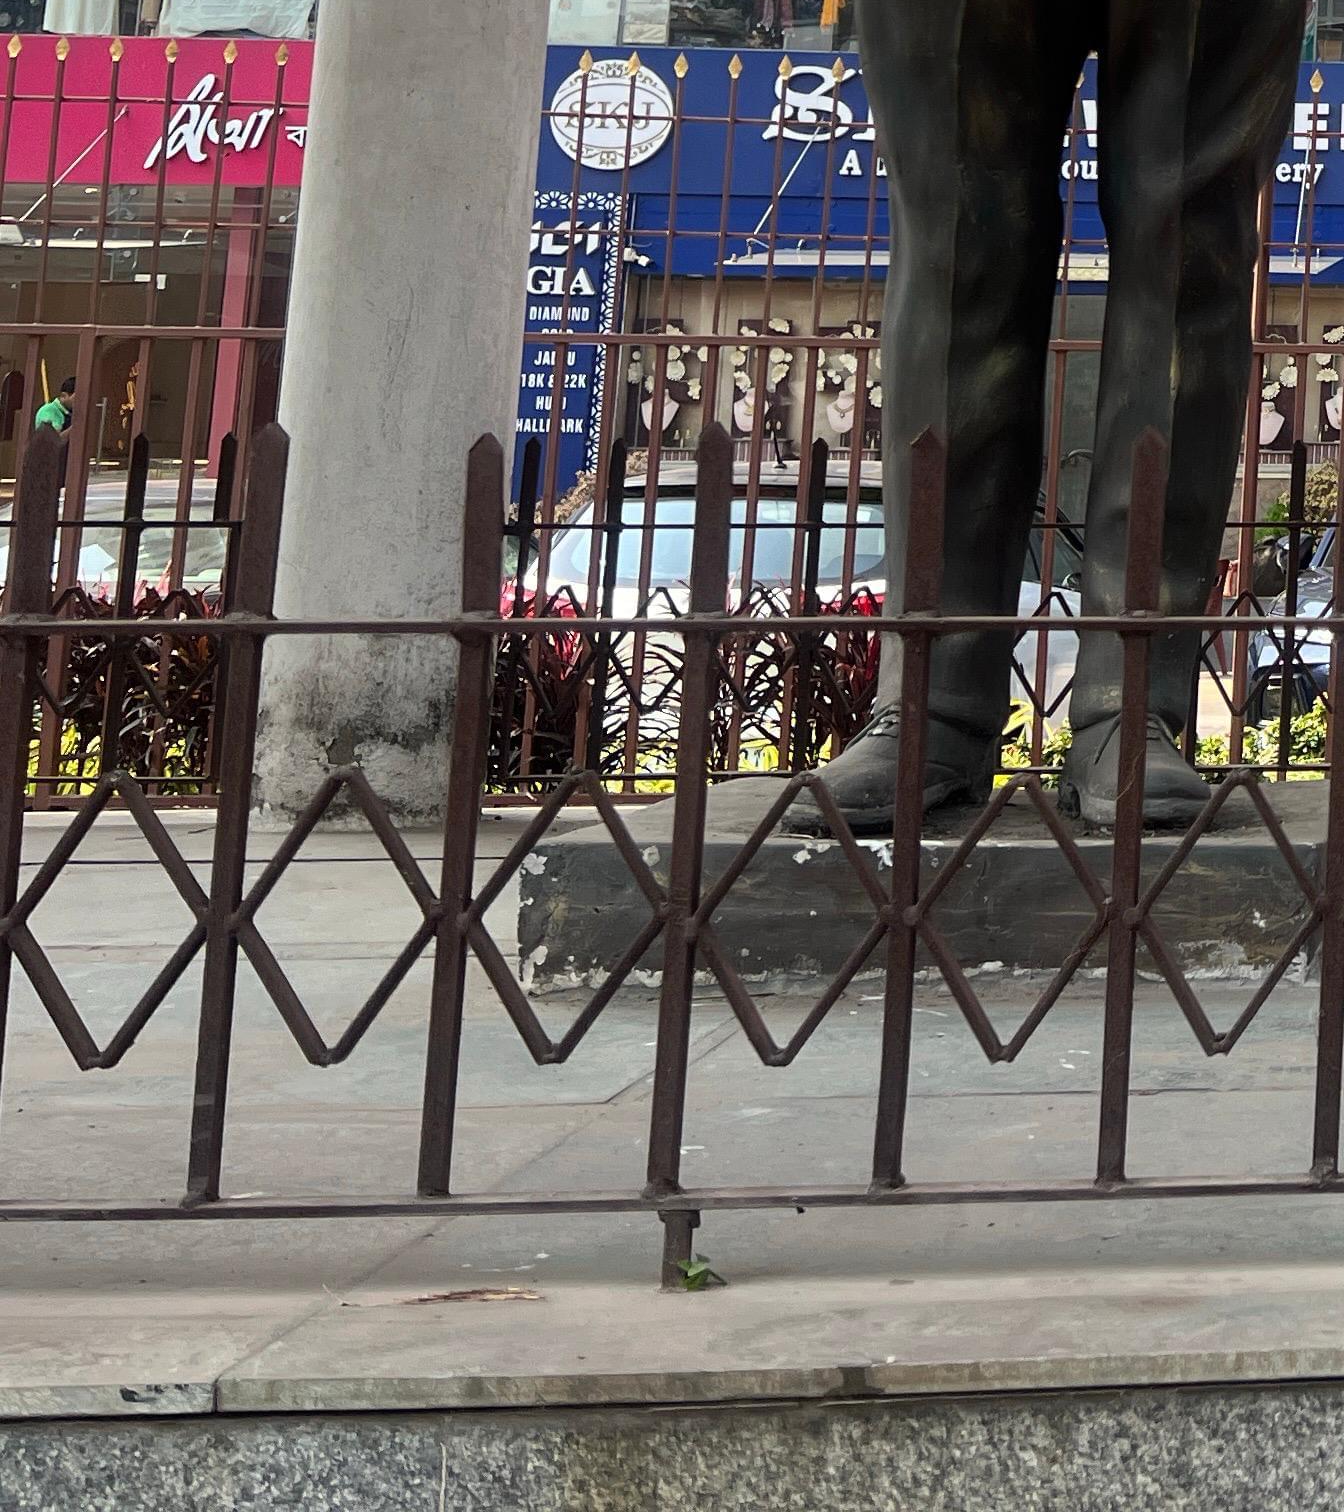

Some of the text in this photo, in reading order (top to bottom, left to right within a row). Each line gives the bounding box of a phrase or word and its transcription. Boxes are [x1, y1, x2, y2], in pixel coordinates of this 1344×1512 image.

[566, 100, 656, 131] SKJ
[526, 265, 597, 296] GIA
[533, 350, 576, 366] JAU
[521, 373, 545, 388] 18K
